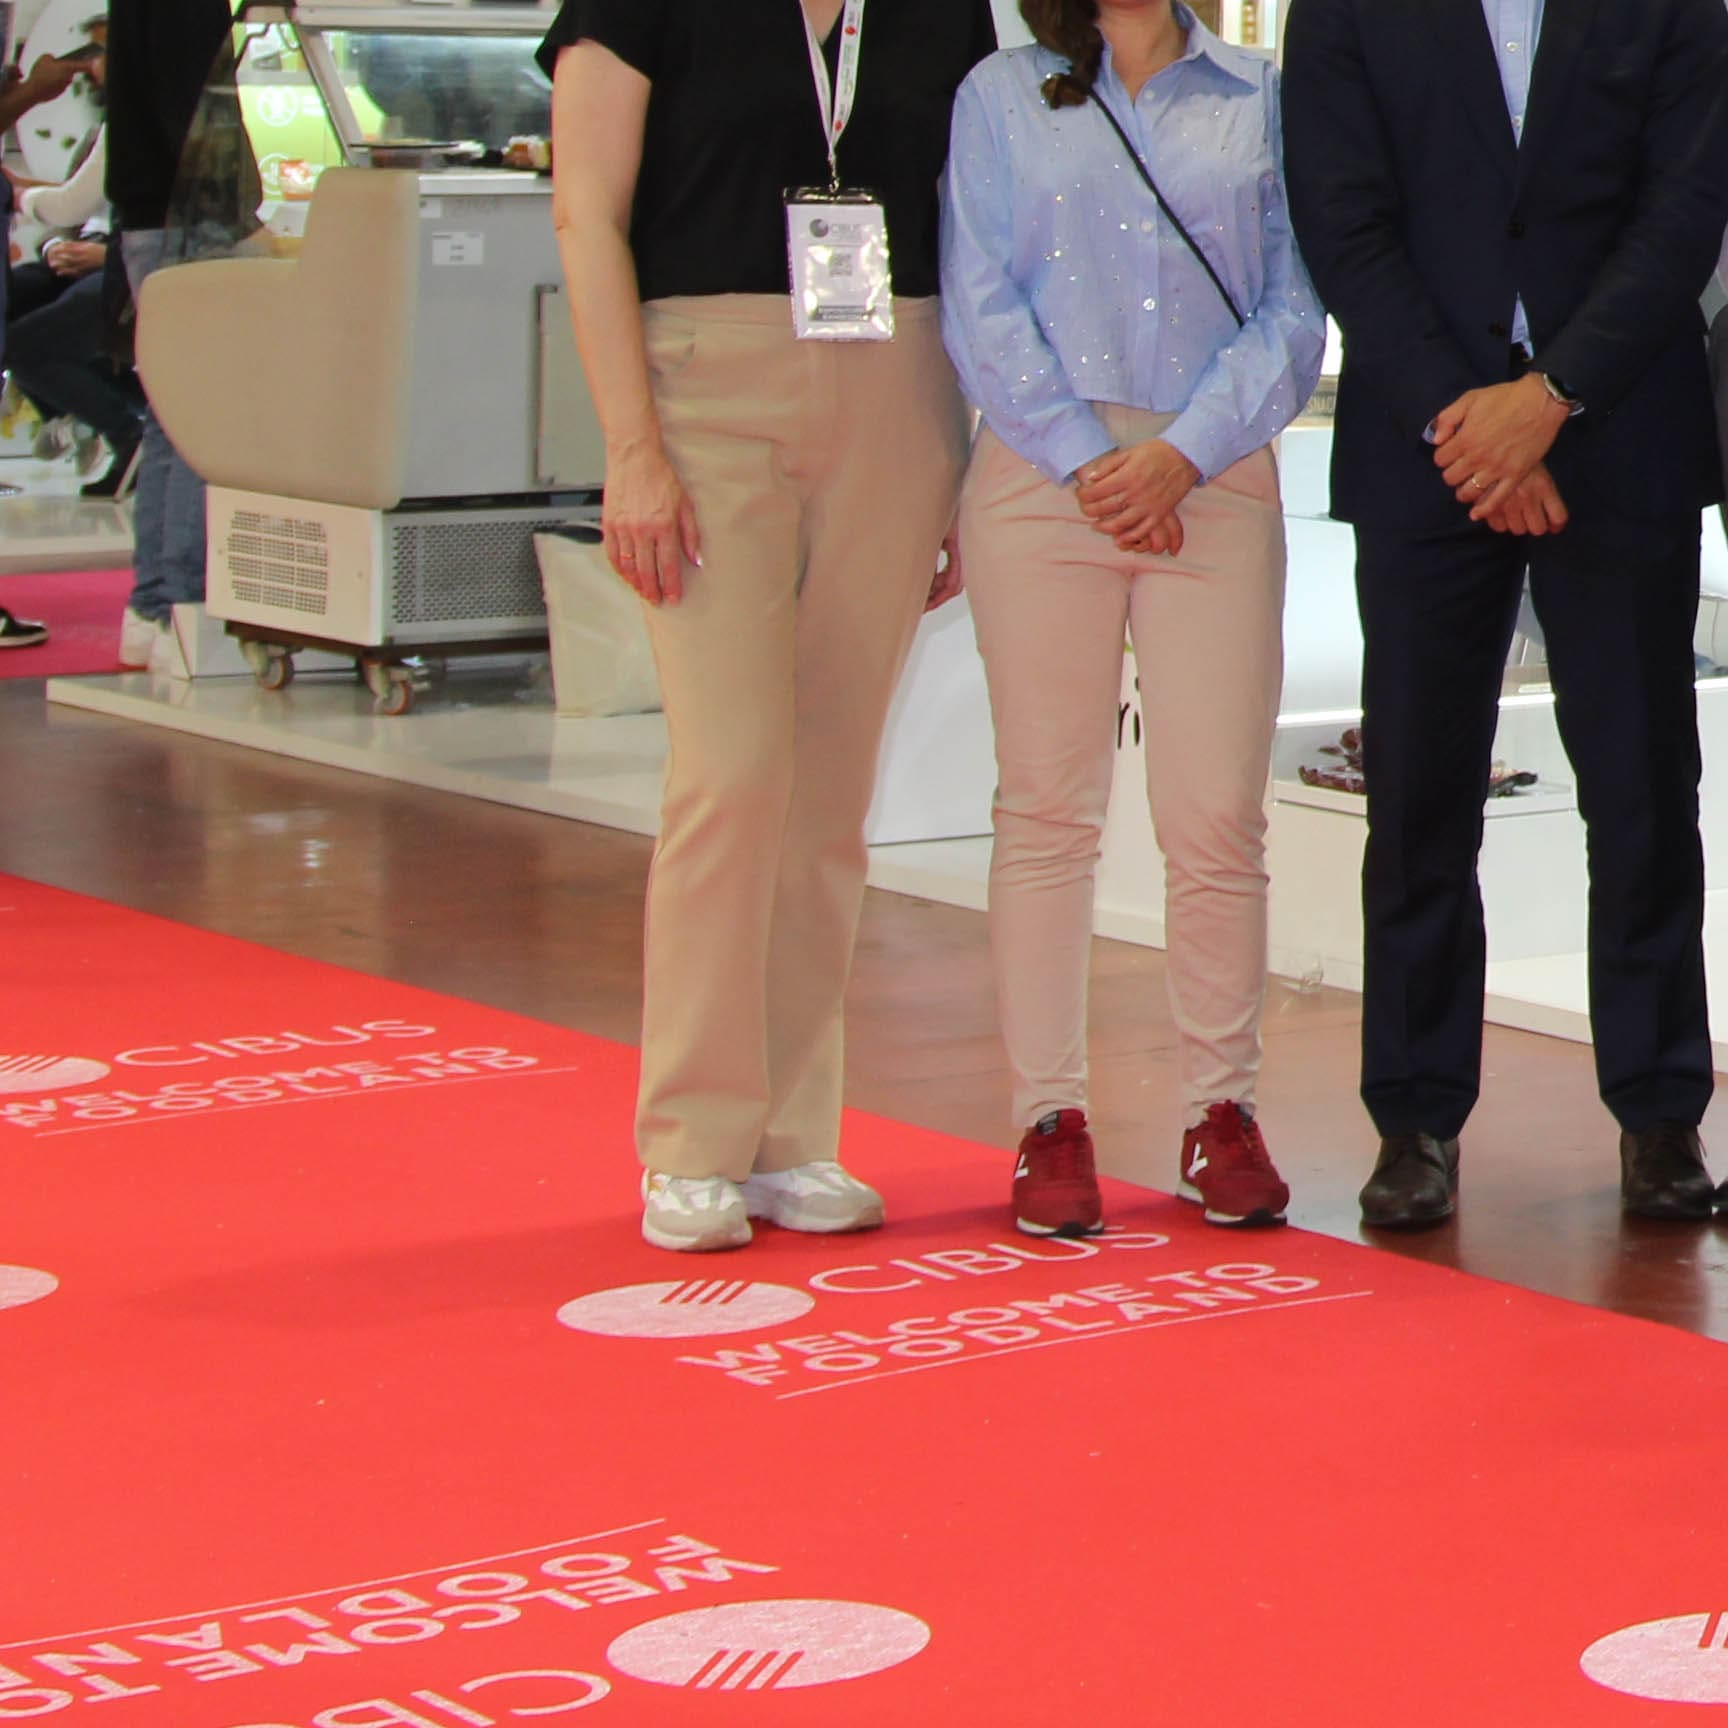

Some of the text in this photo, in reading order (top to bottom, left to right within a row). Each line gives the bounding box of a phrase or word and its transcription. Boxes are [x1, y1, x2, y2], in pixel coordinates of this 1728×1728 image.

[115, 1019, 436, 1067] CIBUS
[0, 1046, 510, 1116] WELCOME TO
[809, 1225, 1170, 1293] CIBUS
[677, 1262, 1277, 1369] WELCOME TO
[725, 1275, 1322, 1385] FOODLAND
[165, 1565, 781, 1682] WELCOME
[228, 1669, 612, 1728] CIB
